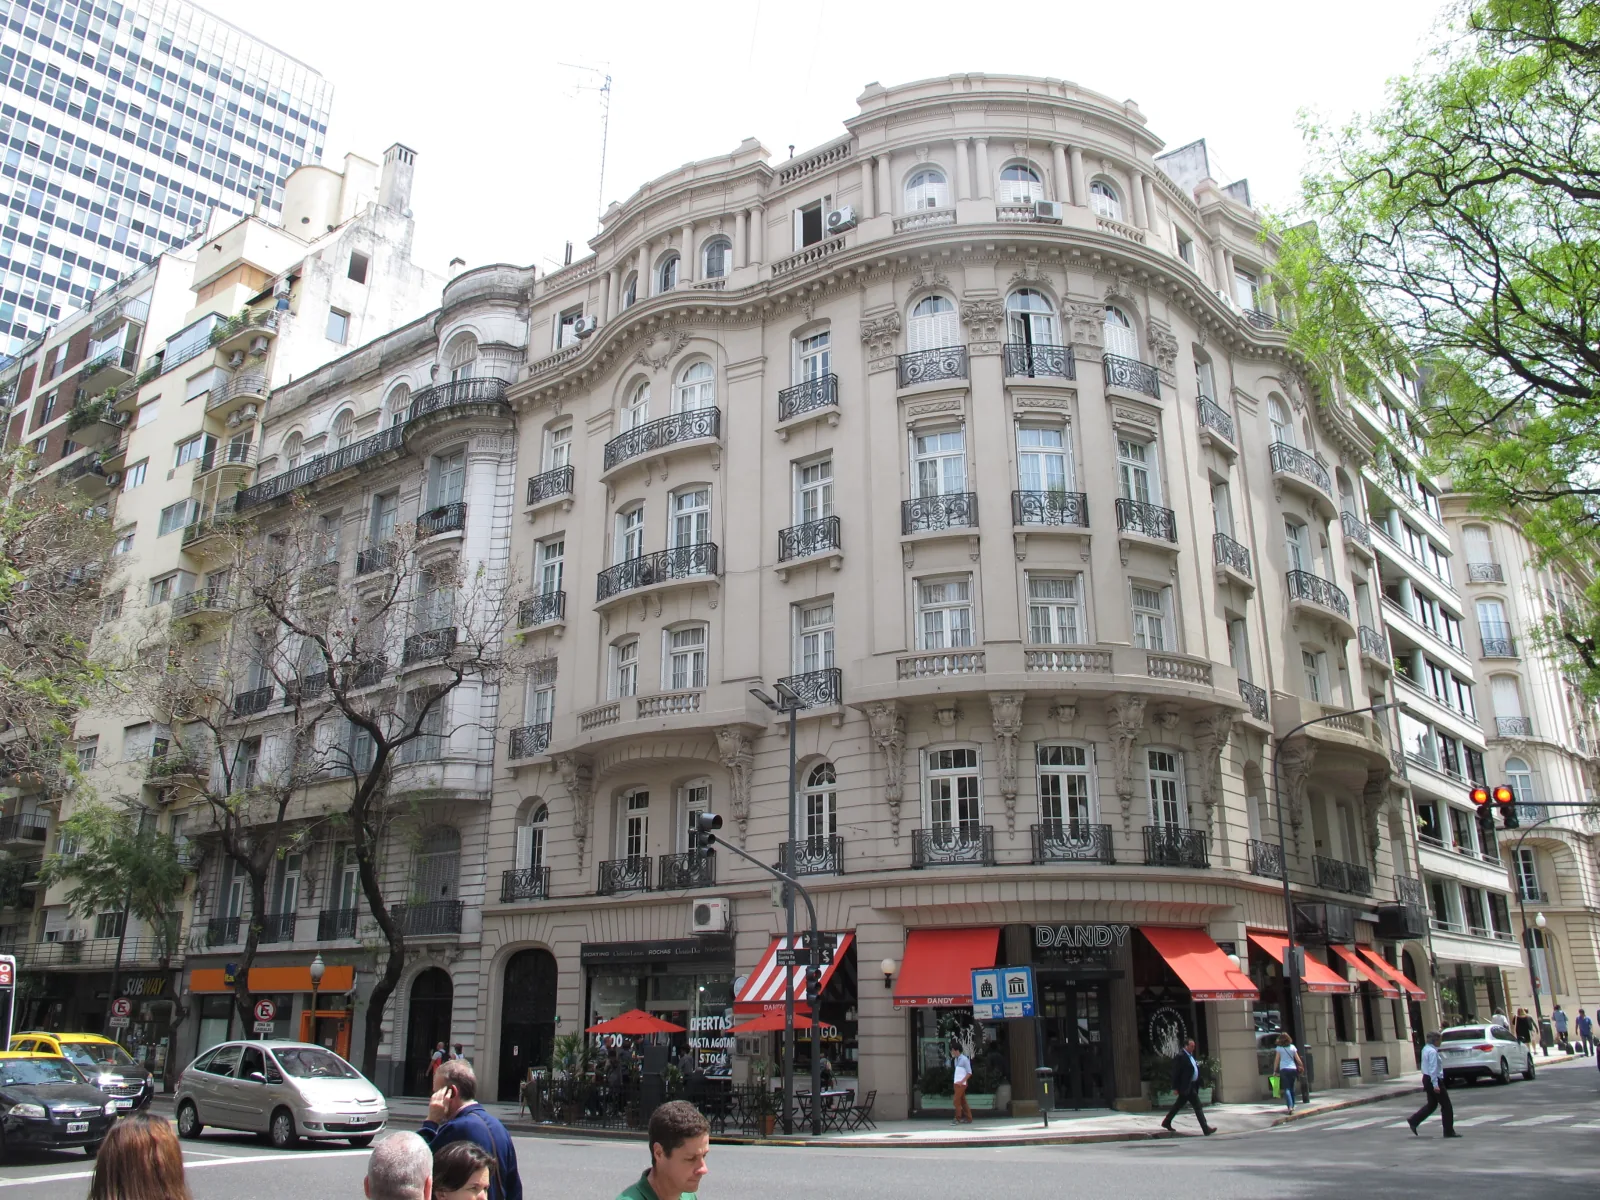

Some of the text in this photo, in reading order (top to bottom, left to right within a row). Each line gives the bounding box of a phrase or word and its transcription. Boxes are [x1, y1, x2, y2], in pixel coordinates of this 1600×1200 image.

[1036, 925, 1129, 947] DANDY
[123, 978, 166, 995] SUBWAY
[690, 1016, 732, 1031] OFERTAS
[689, 1037, 735, 1049] HASTA AGOTAR
[699, 1053, 727, 1064] STOCK
